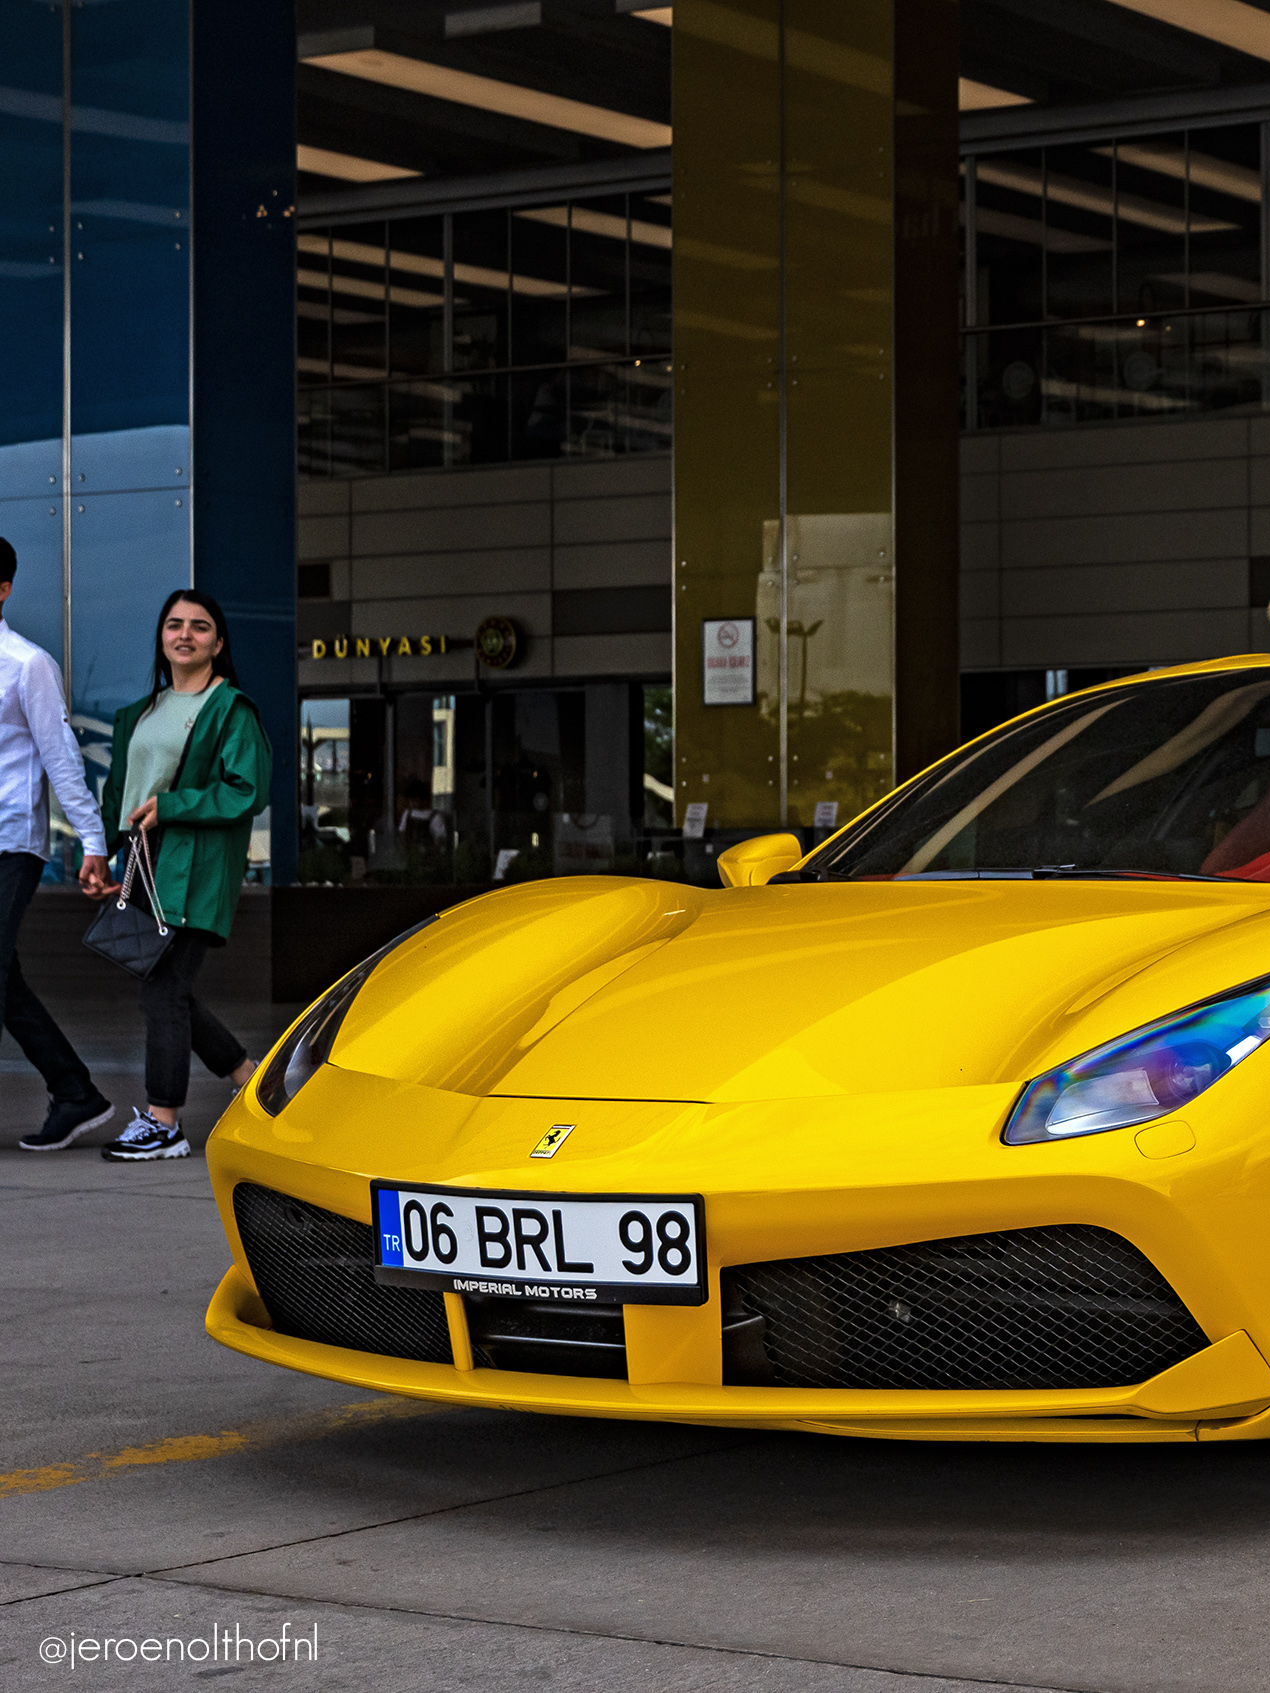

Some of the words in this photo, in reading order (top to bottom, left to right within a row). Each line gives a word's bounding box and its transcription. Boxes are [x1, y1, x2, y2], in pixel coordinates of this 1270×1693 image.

[312, 634, 447, 660] DÜNYASI
[383, 1234, 401, 1252] TR
[402, 1198, 458, 1265] 06
[475, 1205, 595, 1274] BRL
[618, 1209, 692, 1276] 98
[453, 1278, 522, 1296] IMPERIAL
[524, 1284, 598, 1300] MOTORS
